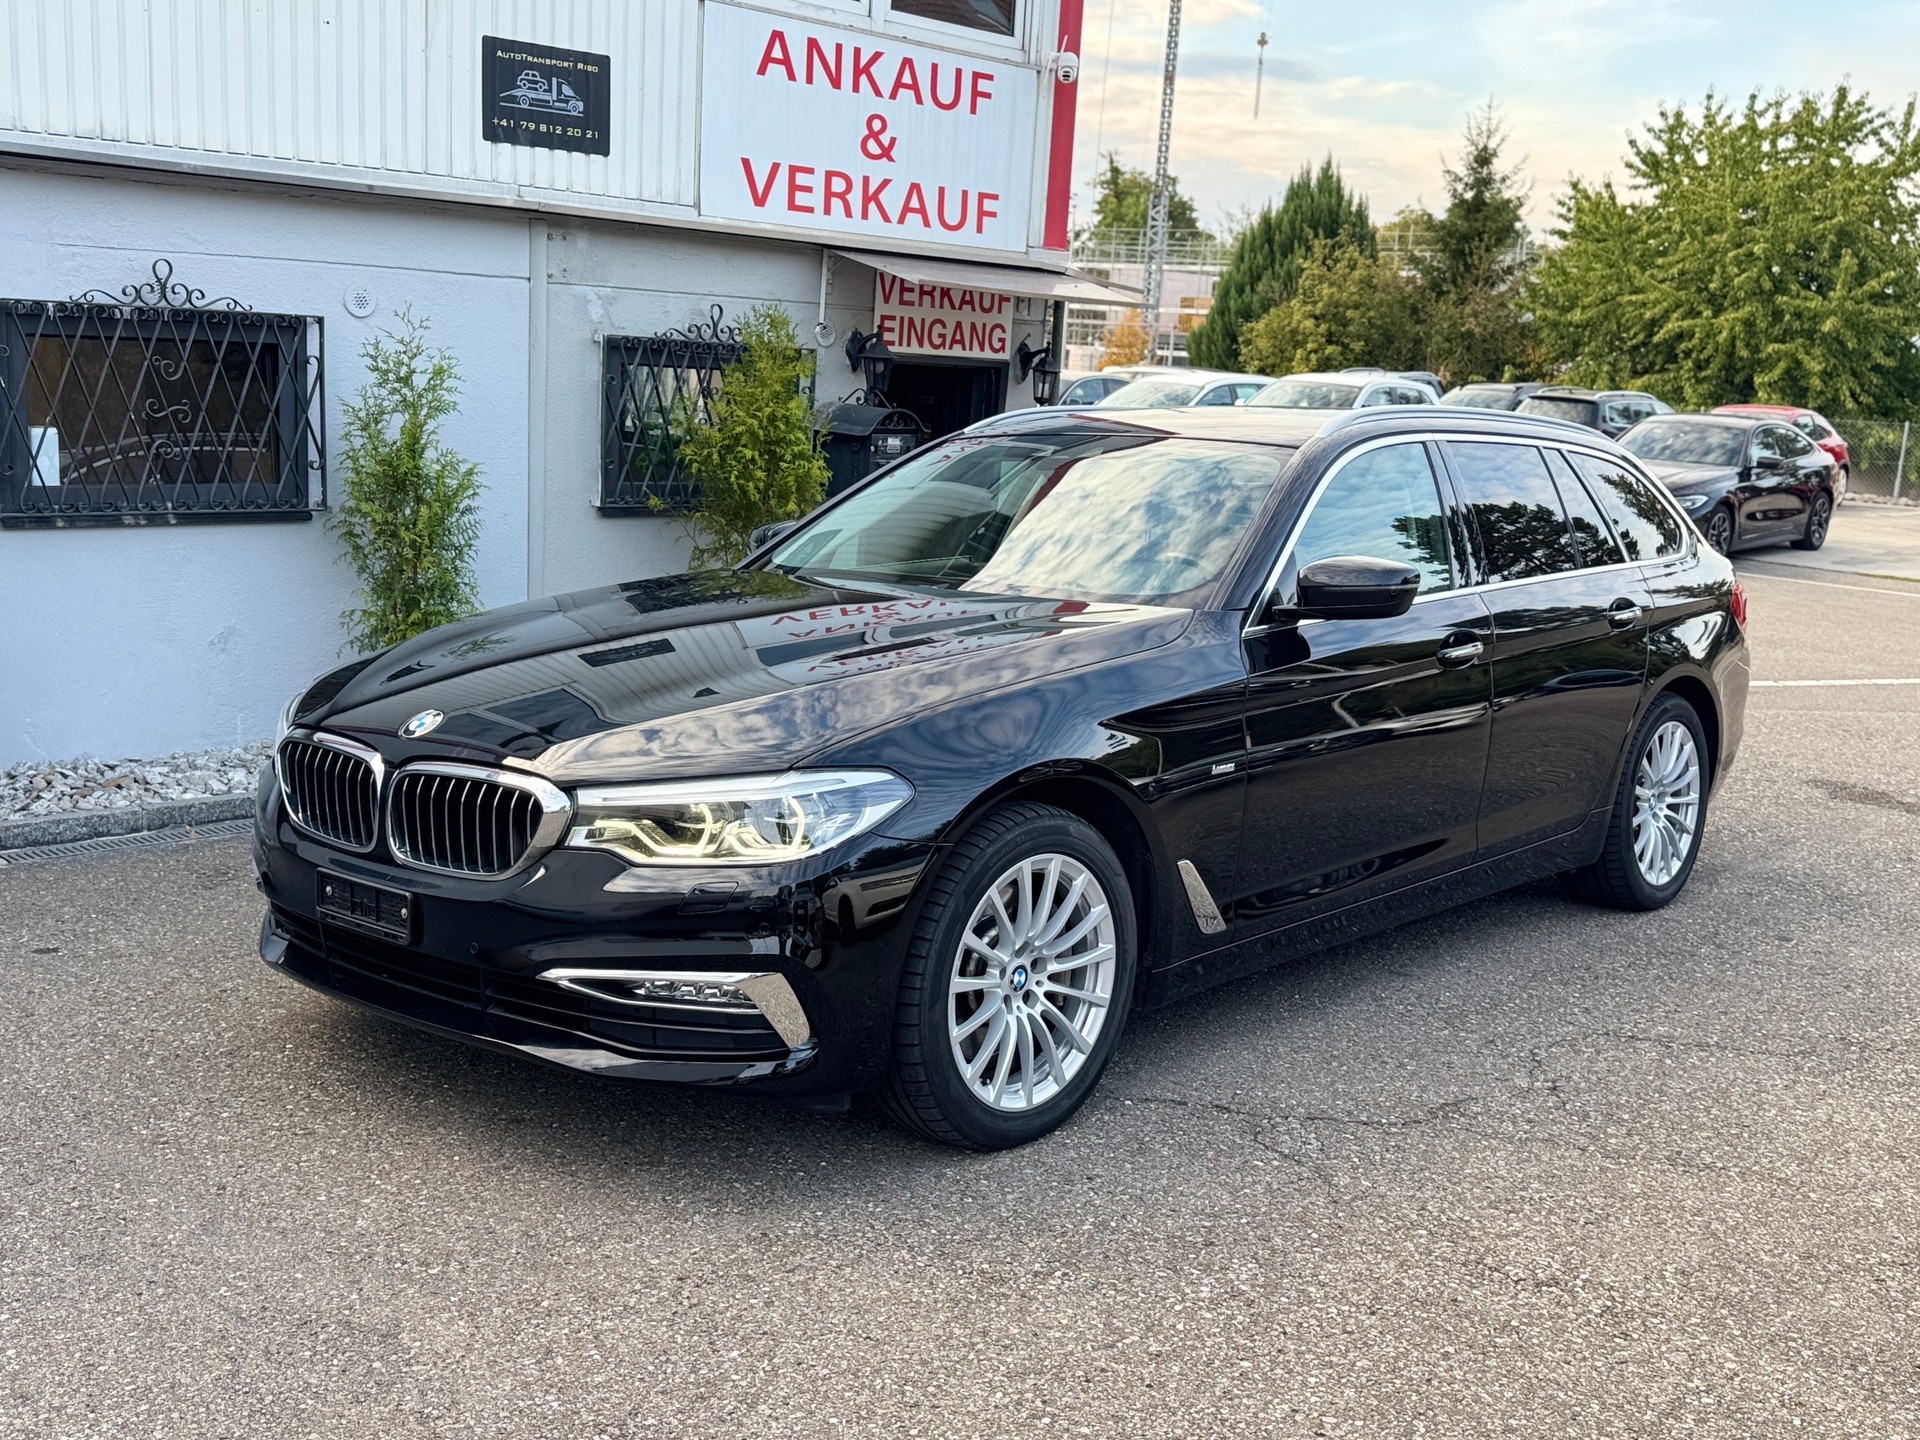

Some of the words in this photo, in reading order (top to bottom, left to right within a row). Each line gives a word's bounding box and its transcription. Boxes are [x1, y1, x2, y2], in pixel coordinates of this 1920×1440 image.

[756, 29, 994, 116] ANKAUF
[492, 117, 514, 128] +41
[520, 121, 536, 131] 79
[539, 124, 562, 134] 812
[567, 128, 582, 137] 20
[586, 130, 599, 139] 21
[860, 113, 897, 163] &
[740, 157, 1000, 235] VERKAUF
[879, 314, 1007, 354] EINGANG
